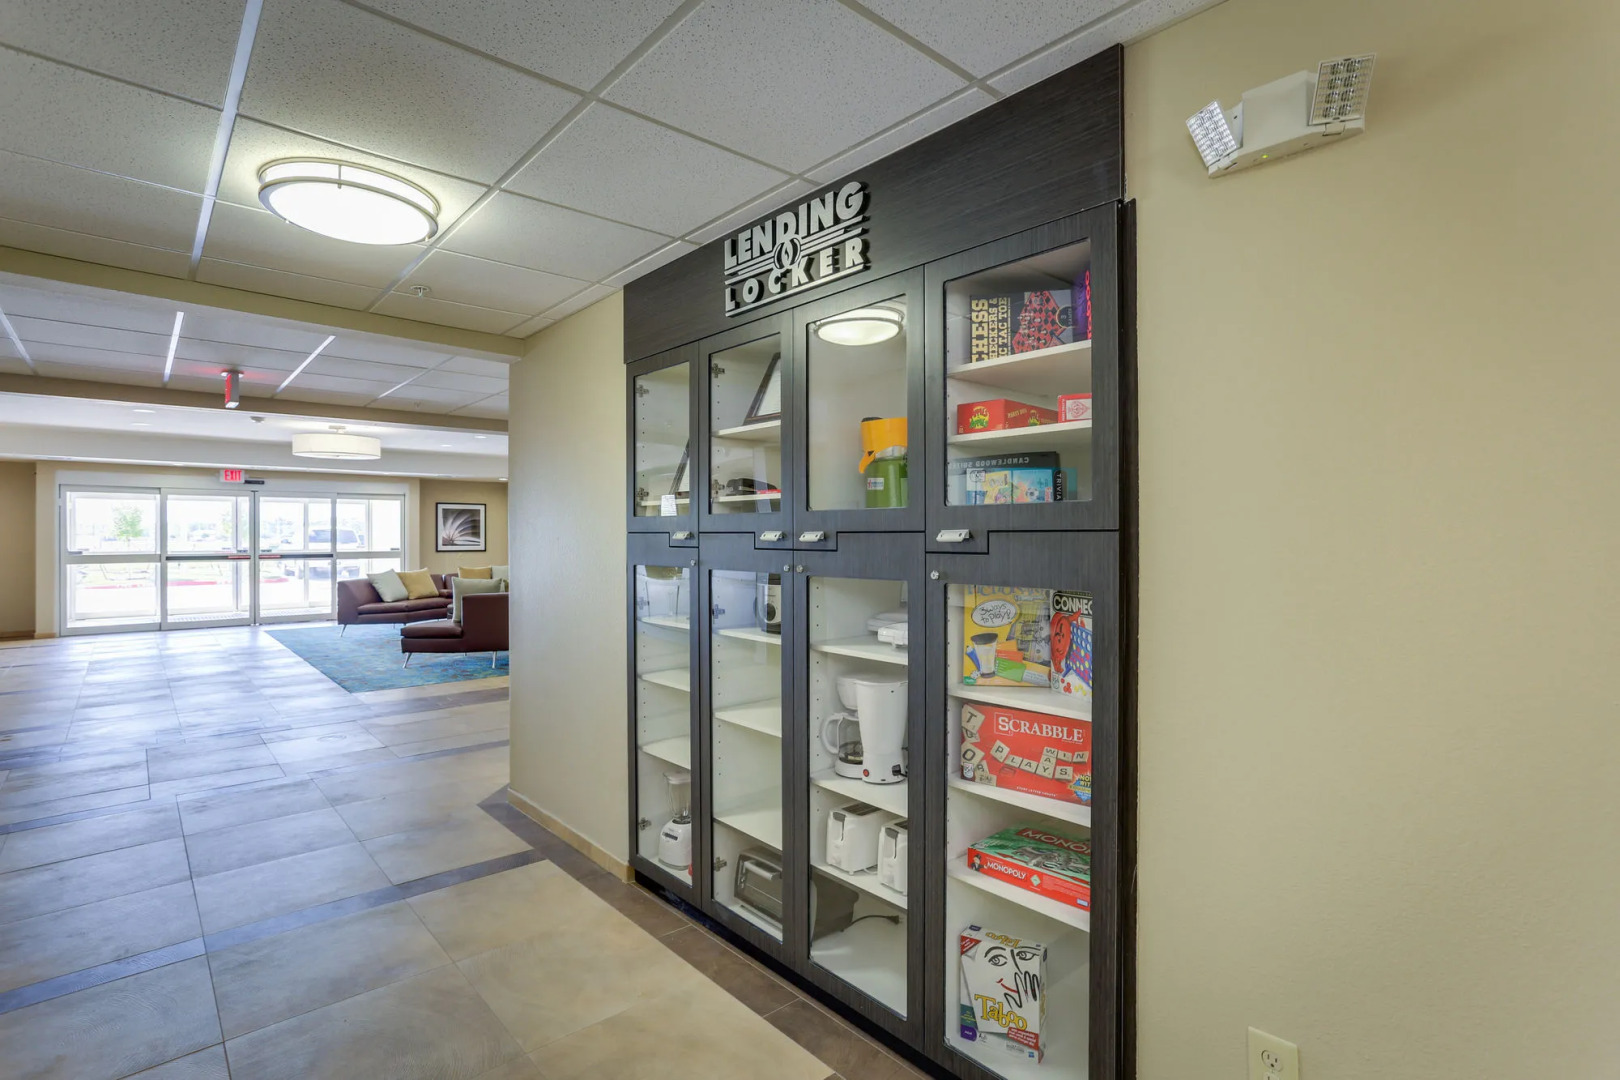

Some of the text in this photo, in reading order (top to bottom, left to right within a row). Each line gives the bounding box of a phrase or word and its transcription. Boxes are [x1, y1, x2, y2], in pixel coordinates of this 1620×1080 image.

[724, 181, 864, 270] LENDING
[725, 237, 864, 312] LOCKER
[998, 297, 1008, 318] TOE
[971, 299, 989, 363] CHESS
[988, 307, 998, 359] HECKERS
[998, 322, 1008, 344] TAC
[224, 469, 242, 481] EXIT
[998, 716, 1084, 743] SCRABBLE
[986, 861, 1027, 880] MONOPOLY
[973, 993, 1028, 1031] Taboo
